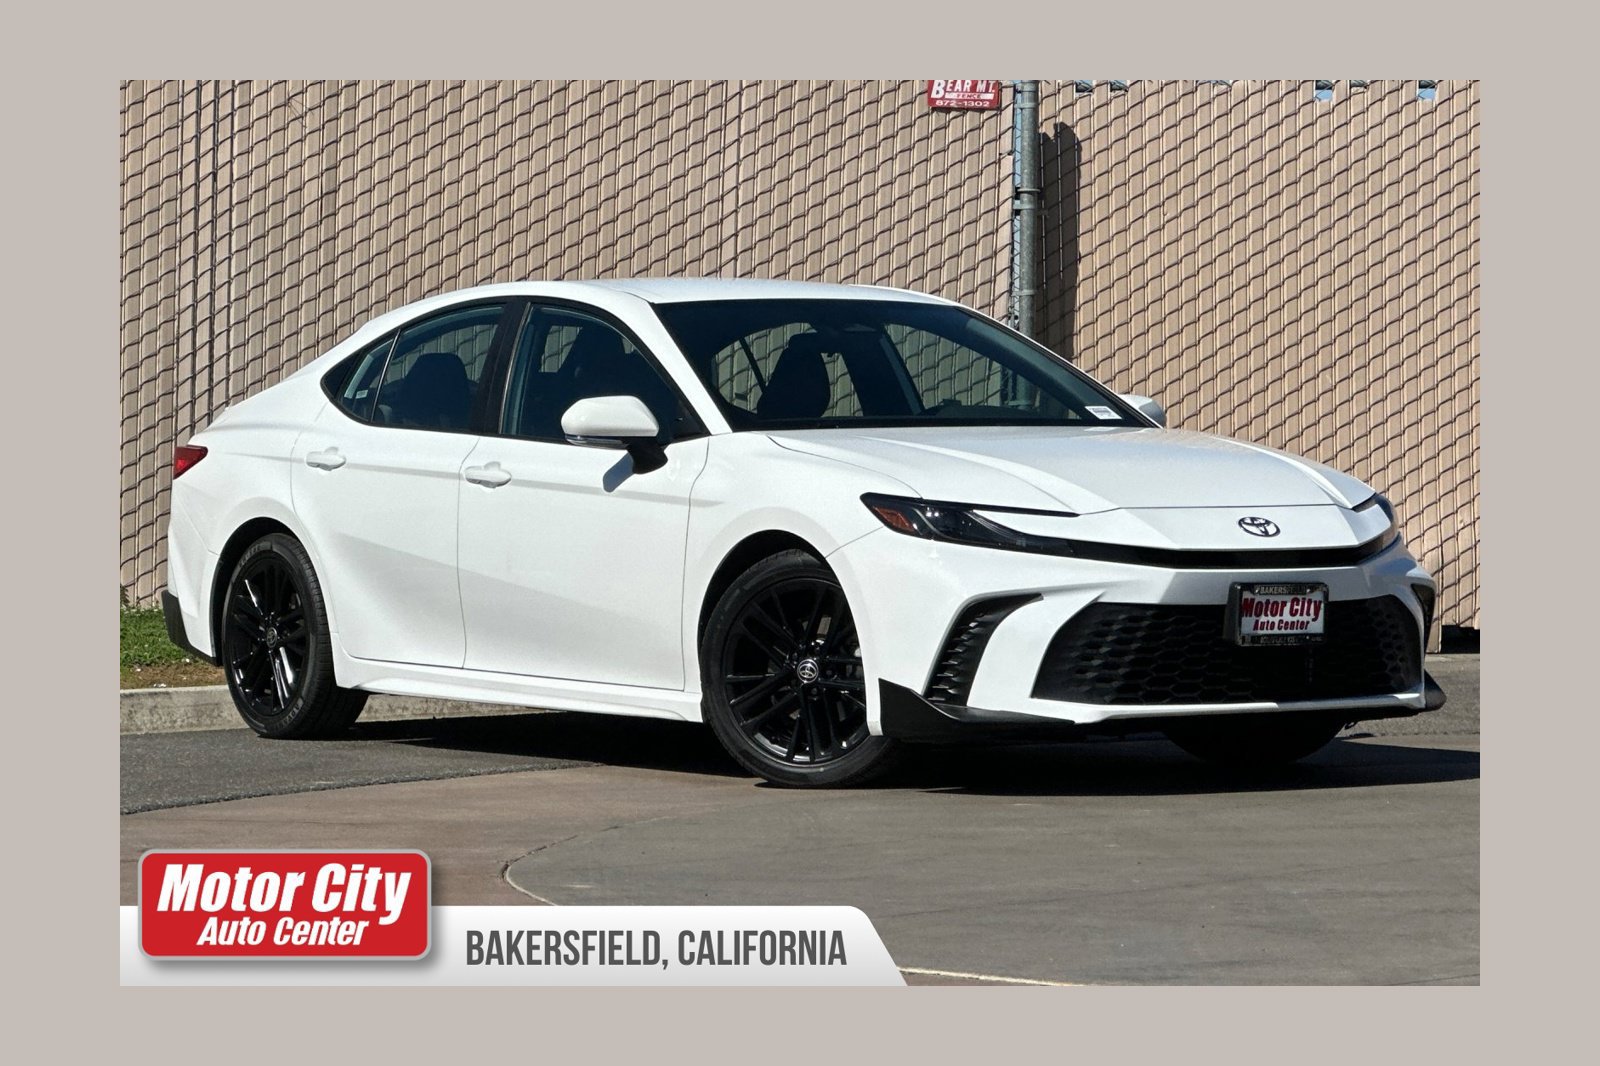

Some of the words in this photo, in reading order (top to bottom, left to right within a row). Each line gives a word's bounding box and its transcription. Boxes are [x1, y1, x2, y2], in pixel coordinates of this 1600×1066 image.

[1241, 597, 1288, 618] Motor
[1289, 597, 1322, 621] City
[1253, 620, 1275, 630] Auto
[1277, 619, 1310, 630] Center
